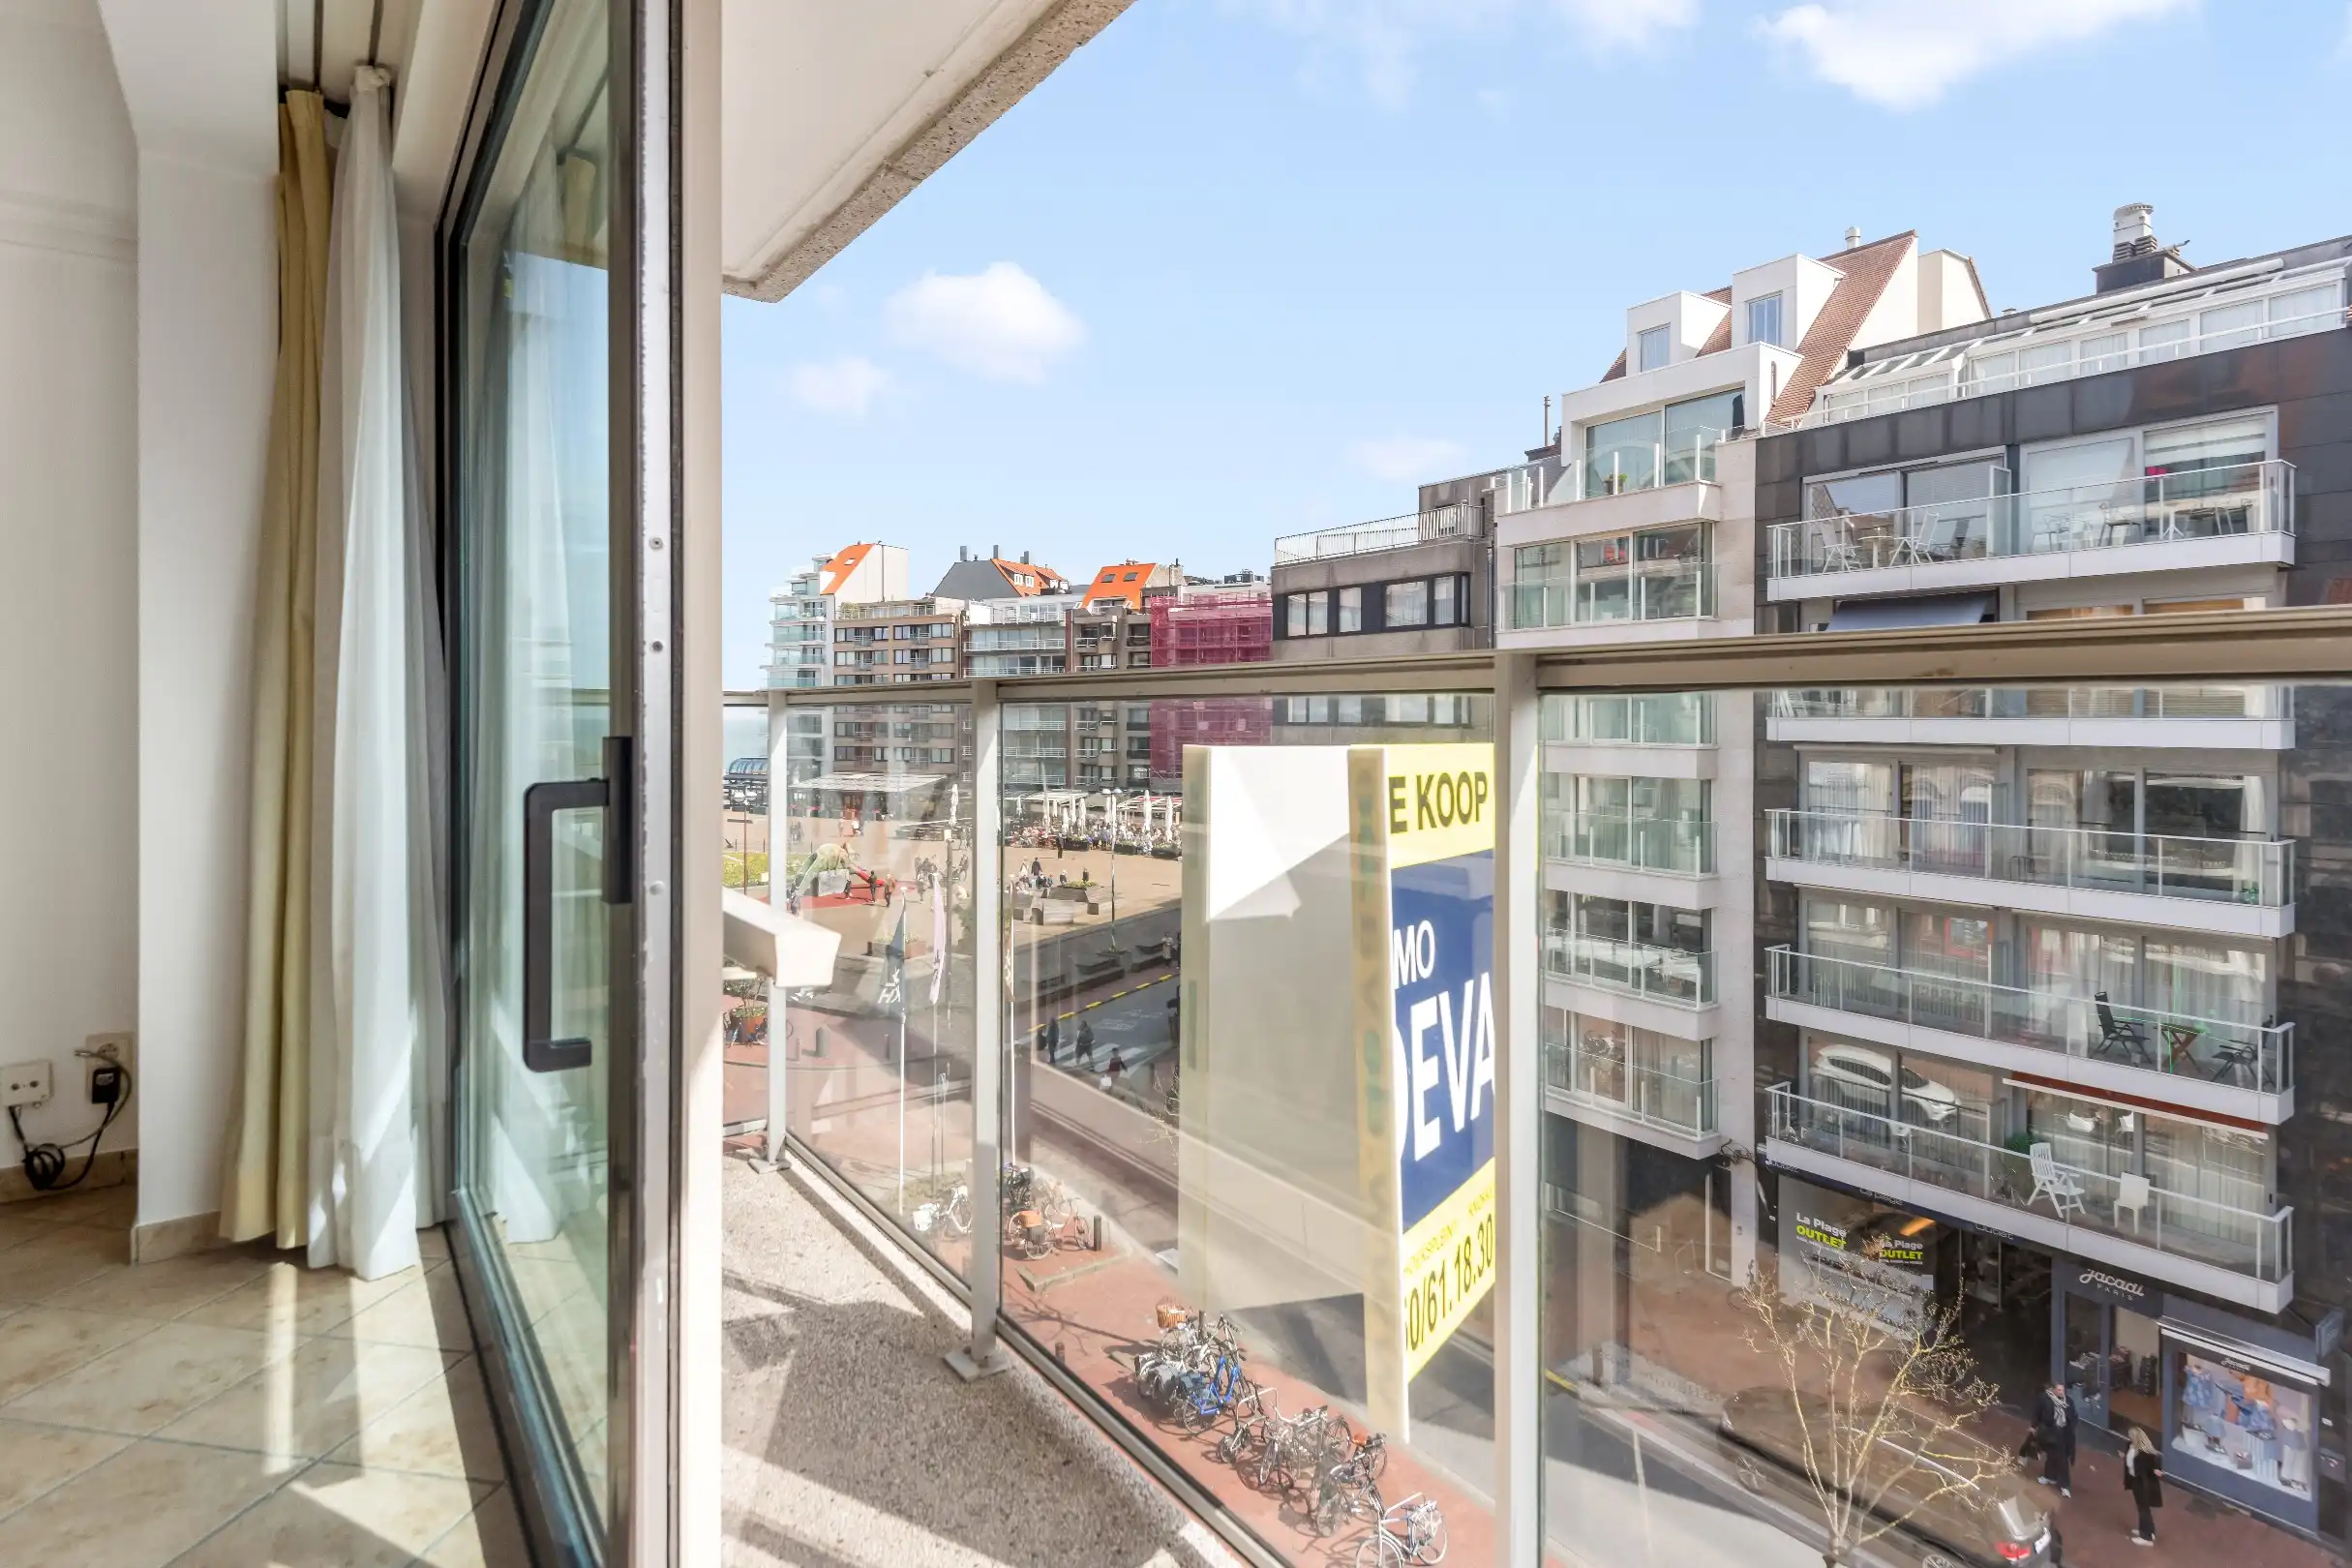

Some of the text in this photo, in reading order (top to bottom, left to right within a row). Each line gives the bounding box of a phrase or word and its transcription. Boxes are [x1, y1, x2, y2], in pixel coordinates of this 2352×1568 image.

[1416, 771, 1488, 830] KOOP
[1393, 971, 1495, 1161] EVA
[1795, 1224, 1847, 1251] OUTLET
[1796, 1212, 1848, 1238] La Plage
[1893, 1240, 1923, 1251] Plage
[1404, 1213, 1493, 1353] 0/61.18.30
[2096, 1282, 2134, 1301] PARIS
